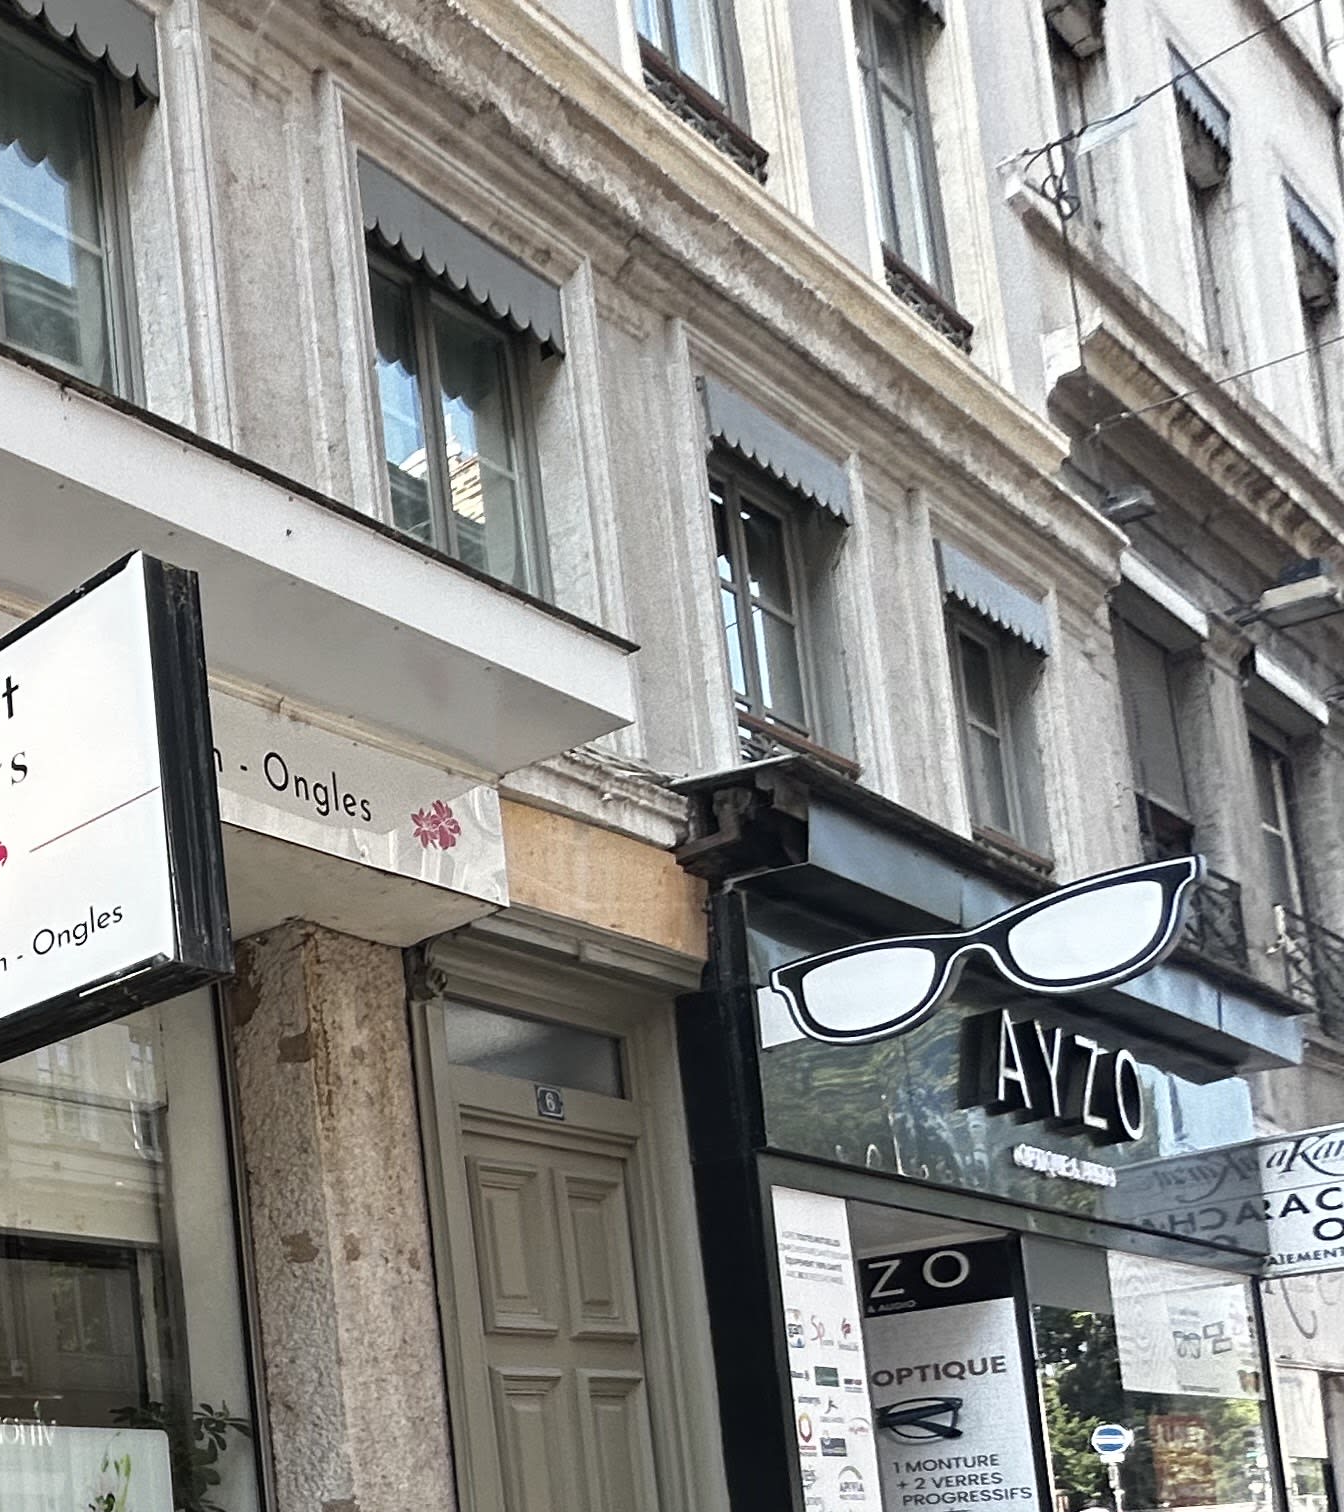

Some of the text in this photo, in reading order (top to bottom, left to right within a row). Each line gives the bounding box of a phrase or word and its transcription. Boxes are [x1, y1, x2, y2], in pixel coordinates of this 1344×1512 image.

[263, 751, 372, 822] Ongles
[32, 903, 123, 958] Ongles
[997, 1008, 1145, 1141] AYZO
[543, 1091, 556, 1113] 6
[872, 1355, 1007, 1387] OPTIQUE
[893, 1454, 1000, 1474] 1 MONTURE
[914, 1477, 926, 1490] 2
[931, 1472, 1004, 1489] VERRES
[902, 1487, 1033, 1507] PROGRESSIFS
